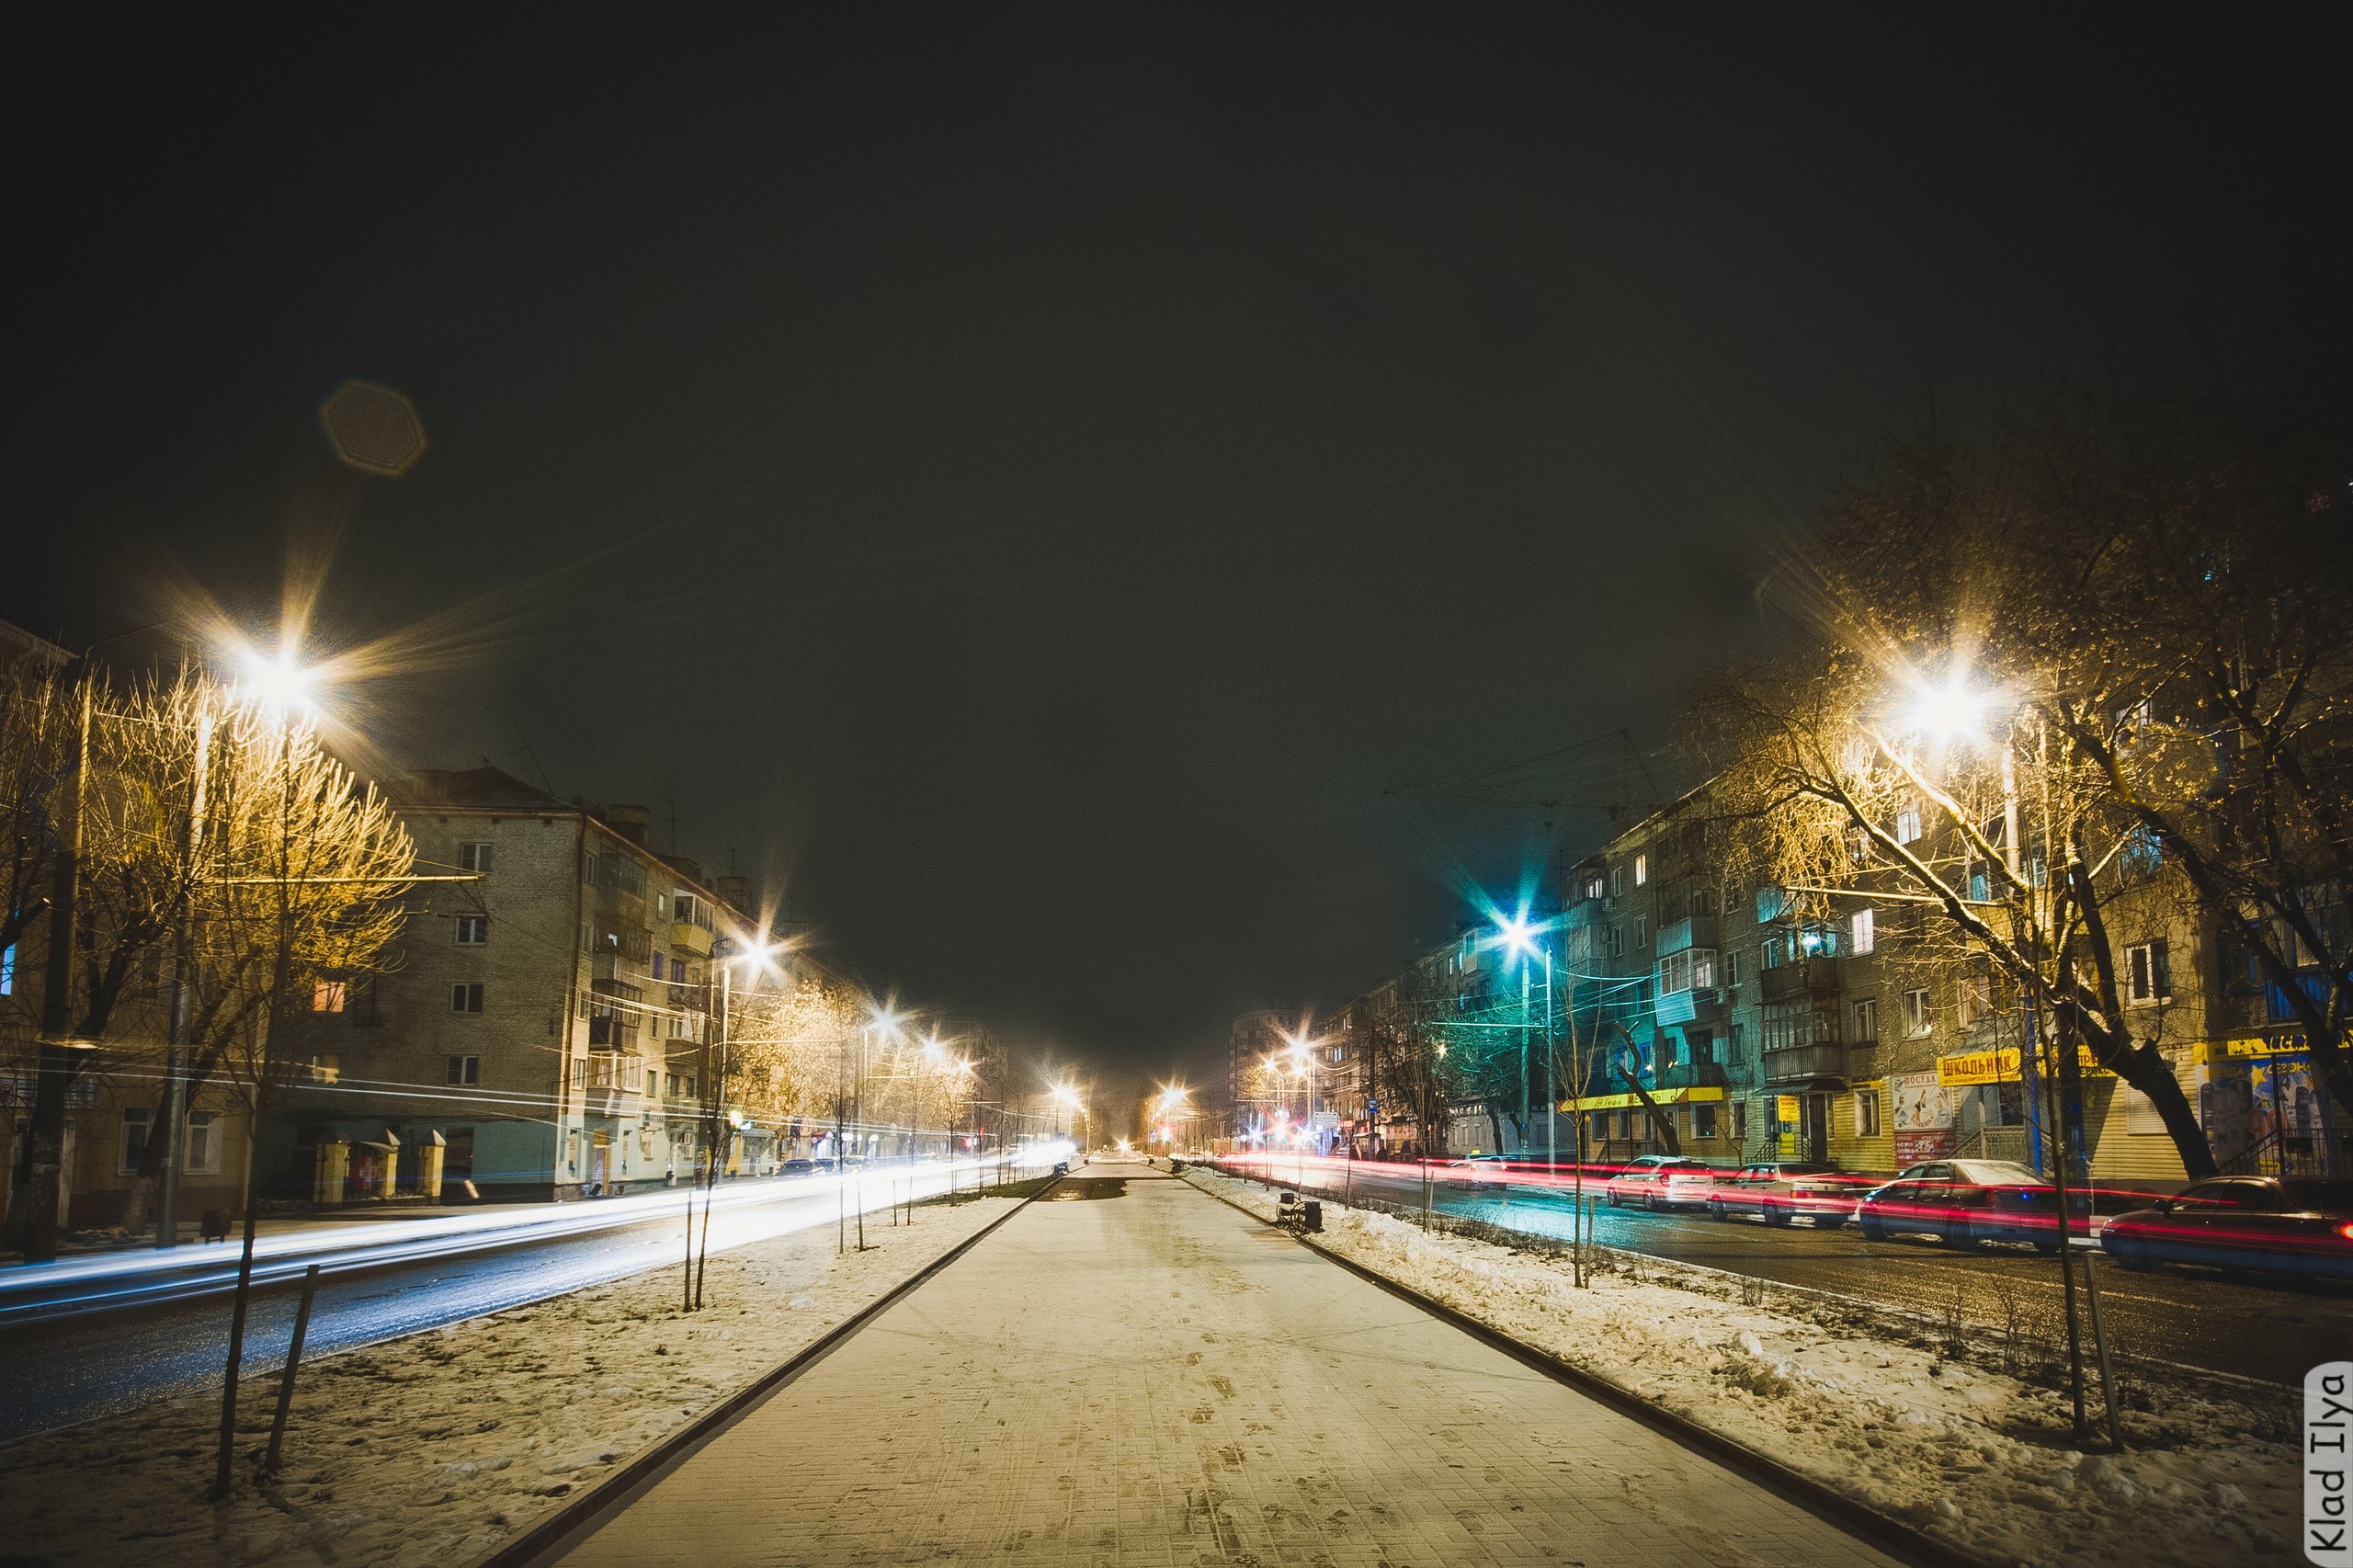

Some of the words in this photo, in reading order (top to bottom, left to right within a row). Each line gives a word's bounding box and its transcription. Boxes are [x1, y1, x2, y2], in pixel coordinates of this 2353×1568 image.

[1943, 1055, 2012, 1076] ШКОЛЬНИК
[1904, 1074, 1936, 1085] ПОСУДА
[1628, 1092, 1661, 1104] МЕЛЬ
